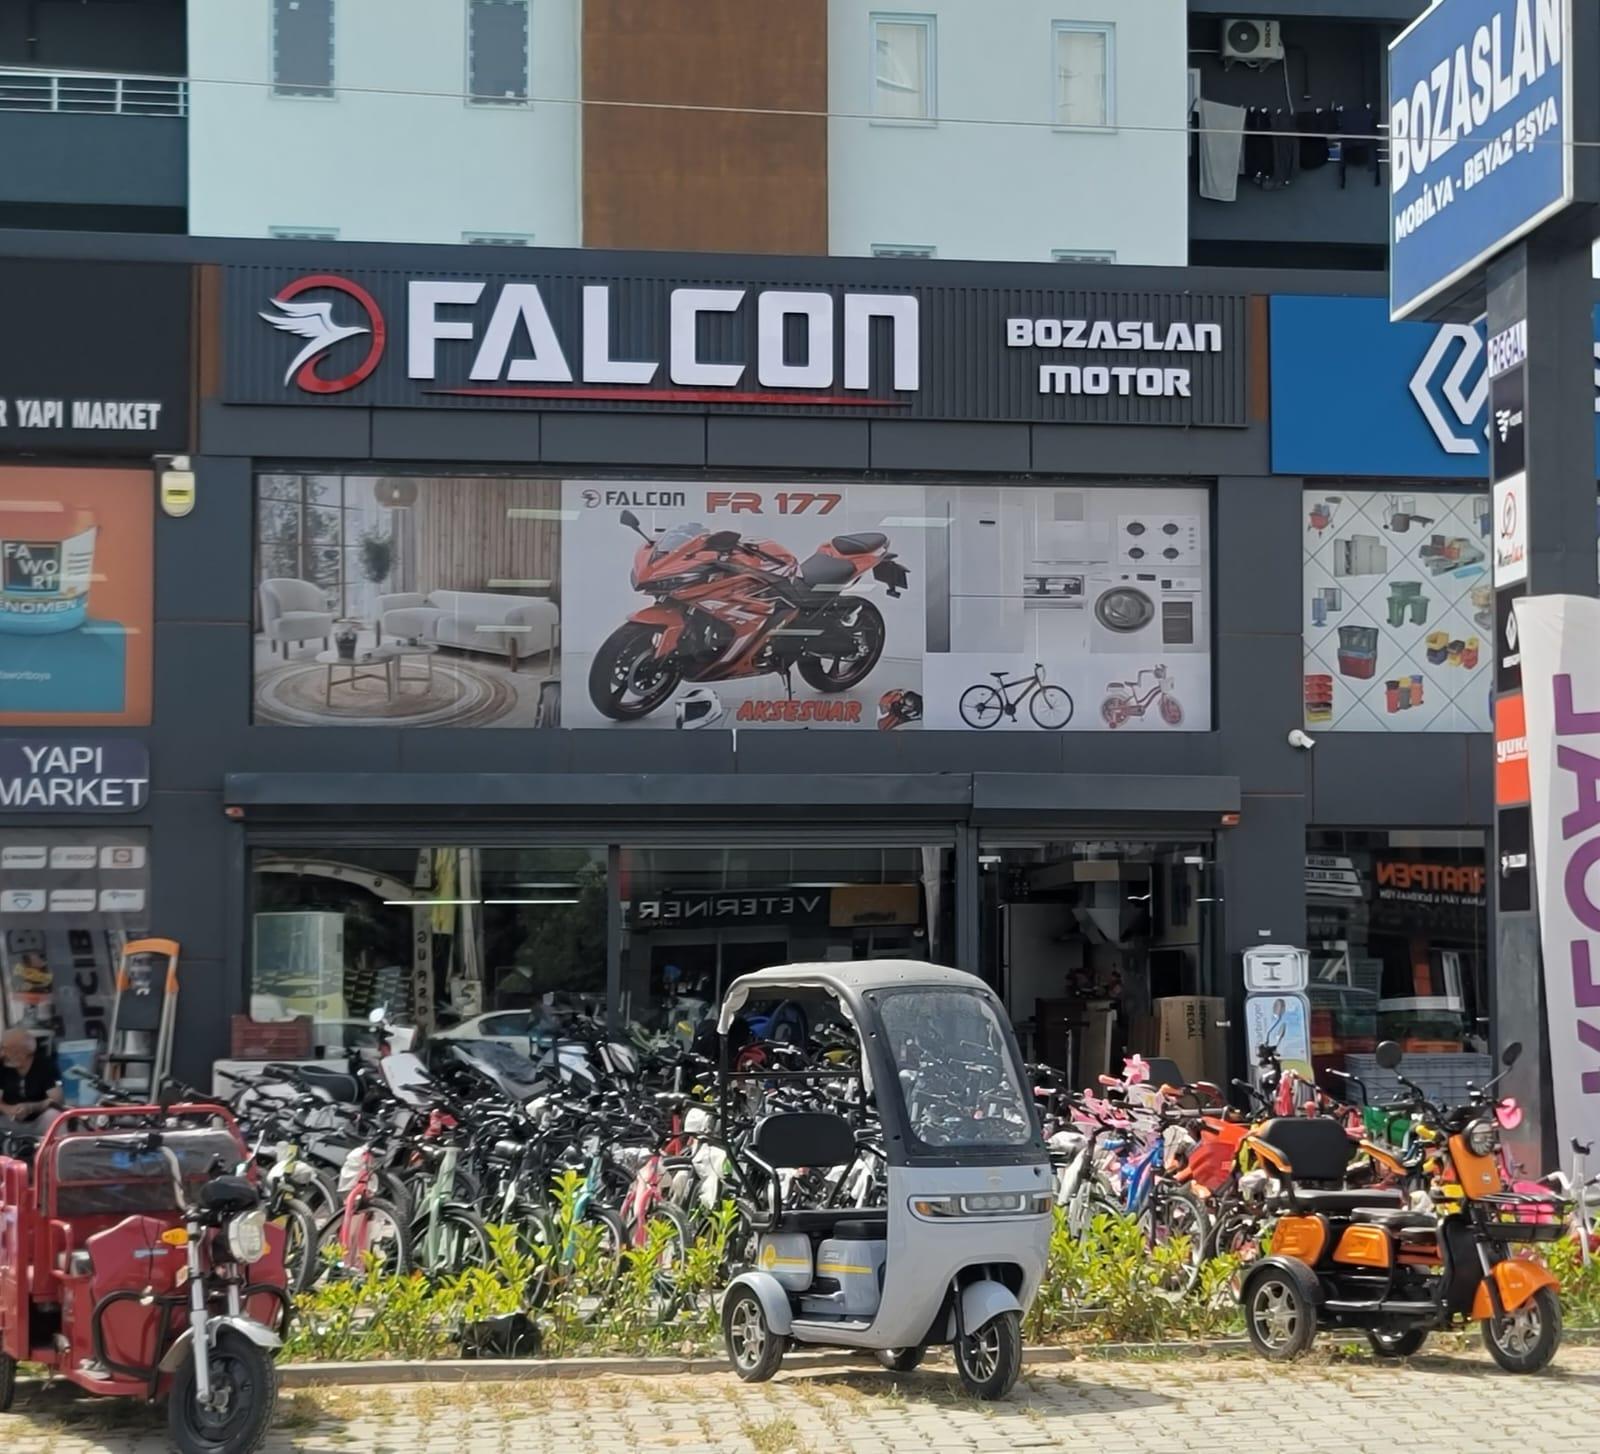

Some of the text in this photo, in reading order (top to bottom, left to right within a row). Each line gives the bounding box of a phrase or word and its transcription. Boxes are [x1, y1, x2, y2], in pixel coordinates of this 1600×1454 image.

[1392, 0, 1560, 194] BOZASLAN
[1395, 175, 1454, 243] MOBİLYA
[1464, 128, 1514, 191] BEYAZ
[1516, 95, 1558, 153] EŞYA
[408, 280, 919, 392] FALCON
[1006, 318, 1222, 352] BOZASLAN
[1493, 322, 1525, 376] REGAL
[1039, 364, 1191, 397] MOTOR
[16, 400, 63, 428] YAPI
[72, 401, 161, 430] MARKET
[605, 491, 685, 507] FALCON
[706, 491, 842, 515] FR 177
[4, 543, 31, 559] FA
[18, 559, 58, 575] WO
[736, 700, 863, 723] AKSESUAR
[22, 746, 103, 774] YAPI
[0, 777, 149, 807] MARKET
